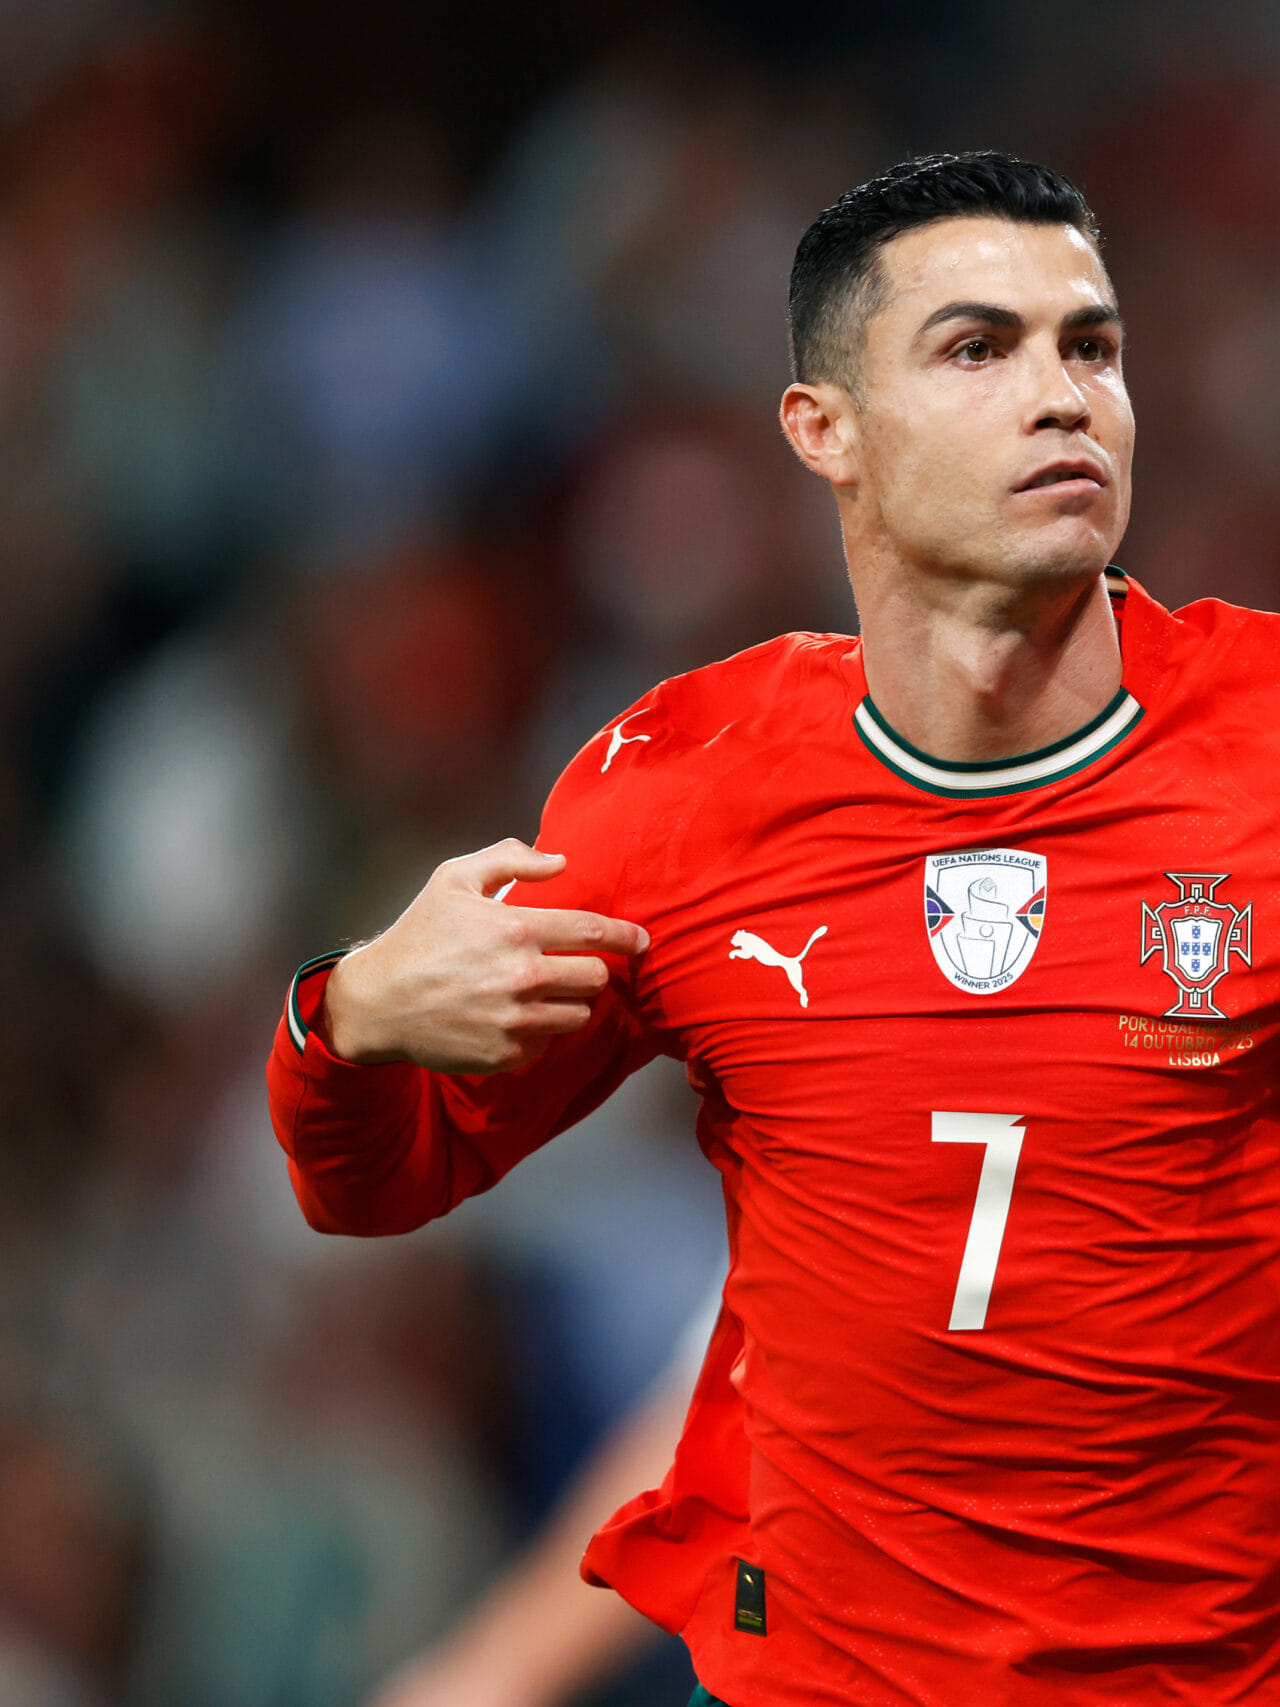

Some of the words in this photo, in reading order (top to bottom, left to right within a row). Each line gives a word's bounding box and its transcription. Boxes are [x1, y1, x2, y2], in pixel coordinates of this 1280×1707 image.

[932, 855, 957, 869] UEFA
[958, 853, 1001, 863] NATIONS
[1003, 855, 1042, 869] LEAGUE
[1184, 905, 1213, 916] F.P.F.
[953, 972, 990, 990] WINNER
[992, 972, 1014, 988] 2025
[1124, 1033, 1138, 1049] 14
[1143, 1034, 1215, 1051] OUTUBRO
[1218, 1034, 1254, 1051] 2025
[1169, 1051, 1221, 1067] LISBOA
[931, 1111, 1027, 1331] 7
